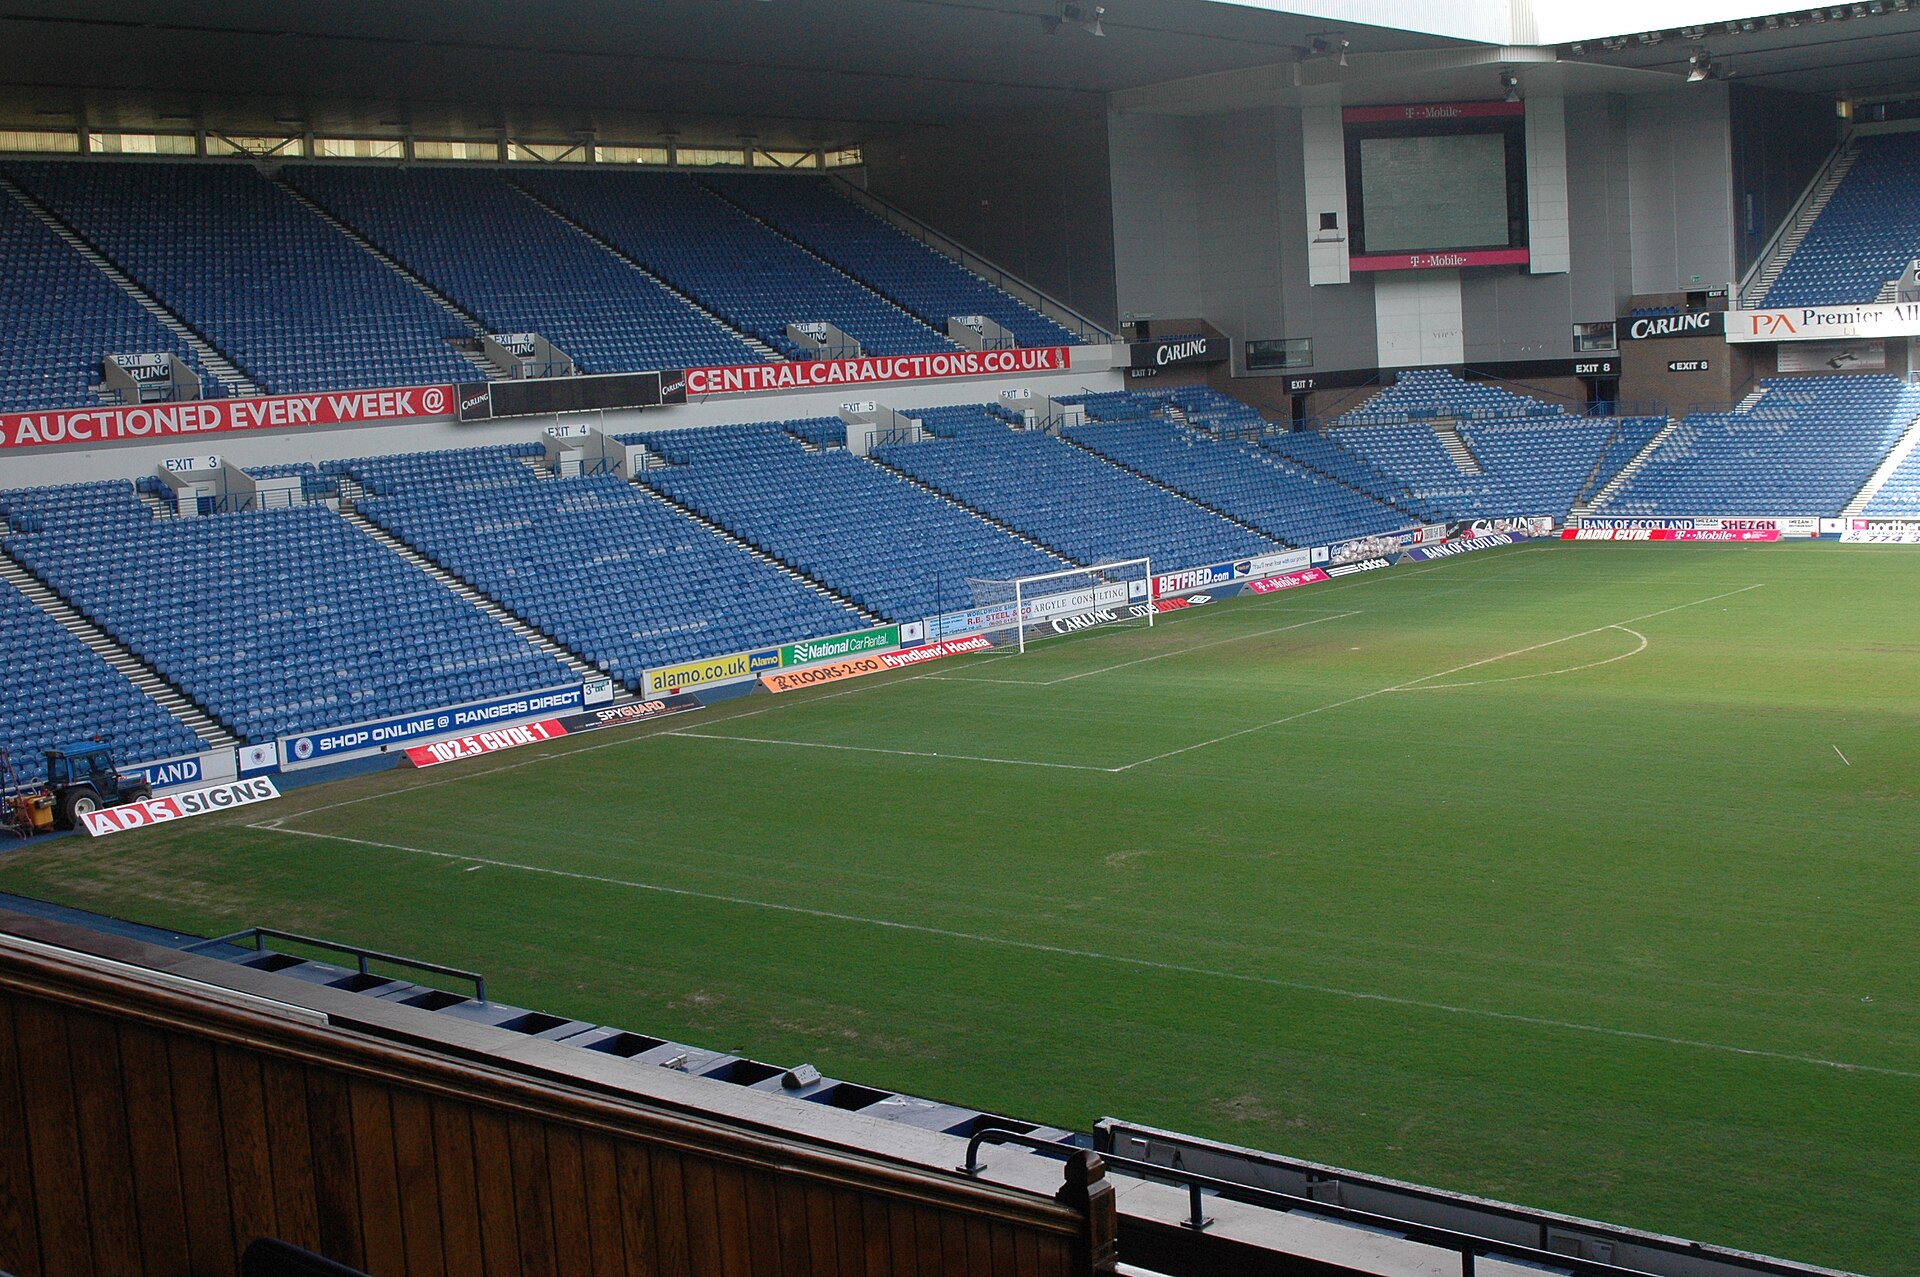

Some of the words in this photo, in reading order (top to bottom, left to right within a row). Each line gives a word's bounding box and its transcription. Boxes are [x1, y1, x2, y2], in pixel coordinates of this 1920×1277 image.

[1802, 307, 1883, 325] Premier
[1631, 312, 1710, 339] CARLING
[494, 335, 513, 344] EXIT
[524, 334, 529, 342] 4
[505, 342, 535, 355] RLING
[1156, 338, 1206, 366] CARLING
[117, 355, 142, 365] EXIT
[154, 354, 162, 363] 3
[1676, 362, 1698, 370] EXIT
[1700, 361, 1708, 369] 8
[130, 365, 169, 381] RLING
[688, 350, 1051, 392] CENTRALCARAUCTIONS.CO.UK
[1131, 369, 1146, 377] EXIT
[1576, 364, 1599, 373] EXIT
[1603, 363, 1610, 372] 8
[662, 380, 686, 395] CARLING
[1291, 380, 1306, 389] EXIT
[1308, 380, 1313, 388] 7
[462, 393, 488, 410] CARLING
[1002, 390, 1017, 399] EXIT
[1023, 389, 1029, 397] 6
[843, 402, 860, 412] EXIT
[868, 401, 874, 410] 5
[15, 405, 221, 444] AUCTIONED
[230, 397, 322, 427] EVERY
[328, 391, 415, 420] WEEK
[422, 388, 445, 414] @
[548, 426, 569, 437] EXIT
[579, 424, 586, 435] 4
[166, 458, 194, 471] EXIT
[208, 456, 217, 468] 3
[1583, 520, 1612, 530] BANK
[1614, 520, 1630, 529] OF
[1631, 520, 1693, 530] SCOTLAND
[1721, 520, 1776, 530] SHEZAN
[1413, 531, 1422, 542] TV
[1575, 529, 1614, 540] RADIO
[1614, 529, 1653, 540] CLYDE
[1421, 545, 1452, 560] BANK
[1447, 541, 1466, 554] OF
[1462, 534, 1513, 552] SCOTLAND
[1358, 557, 1390, 571] adidas
[1159, 568, 1229, 593] BETFRED.com
[1034, 599, 1067, 613] ARGYLE
[1071, 588, 1124, 606] CONSULTING
[986, 612, 1010, 622] STEEL
[1021, 606, 1032, 615] CO
[1051, 608, 1118, 634] CARLING
[808, 642, 850, 660] National
[881, 645, 946, 667] Hyndland
[944, 636, 990, 654] Honda
[750, 655, 778, 669] Alamo
[653, 658, 746, 690] alamo.co.uk
[791, 659, 879, 686] FLOORS-2-GO
[596, 700, 666, 721] SPYGUARD
[320, 731, 369, 751] SHOP
[372, 718, 435, 741] ONLINE
[437, 716, 450, 728] @
[455, 701, 528, 725] RANGERS
[530, 691, 581, 711] DIRECT
[427, 736, 483, 762] 102.5
[480, 725, 538, 751] CLYDE
[533, 722, 551, 739] 1
[146, 761, 198, 785] LAND
[181, 780, 272, 813] SIGNS
